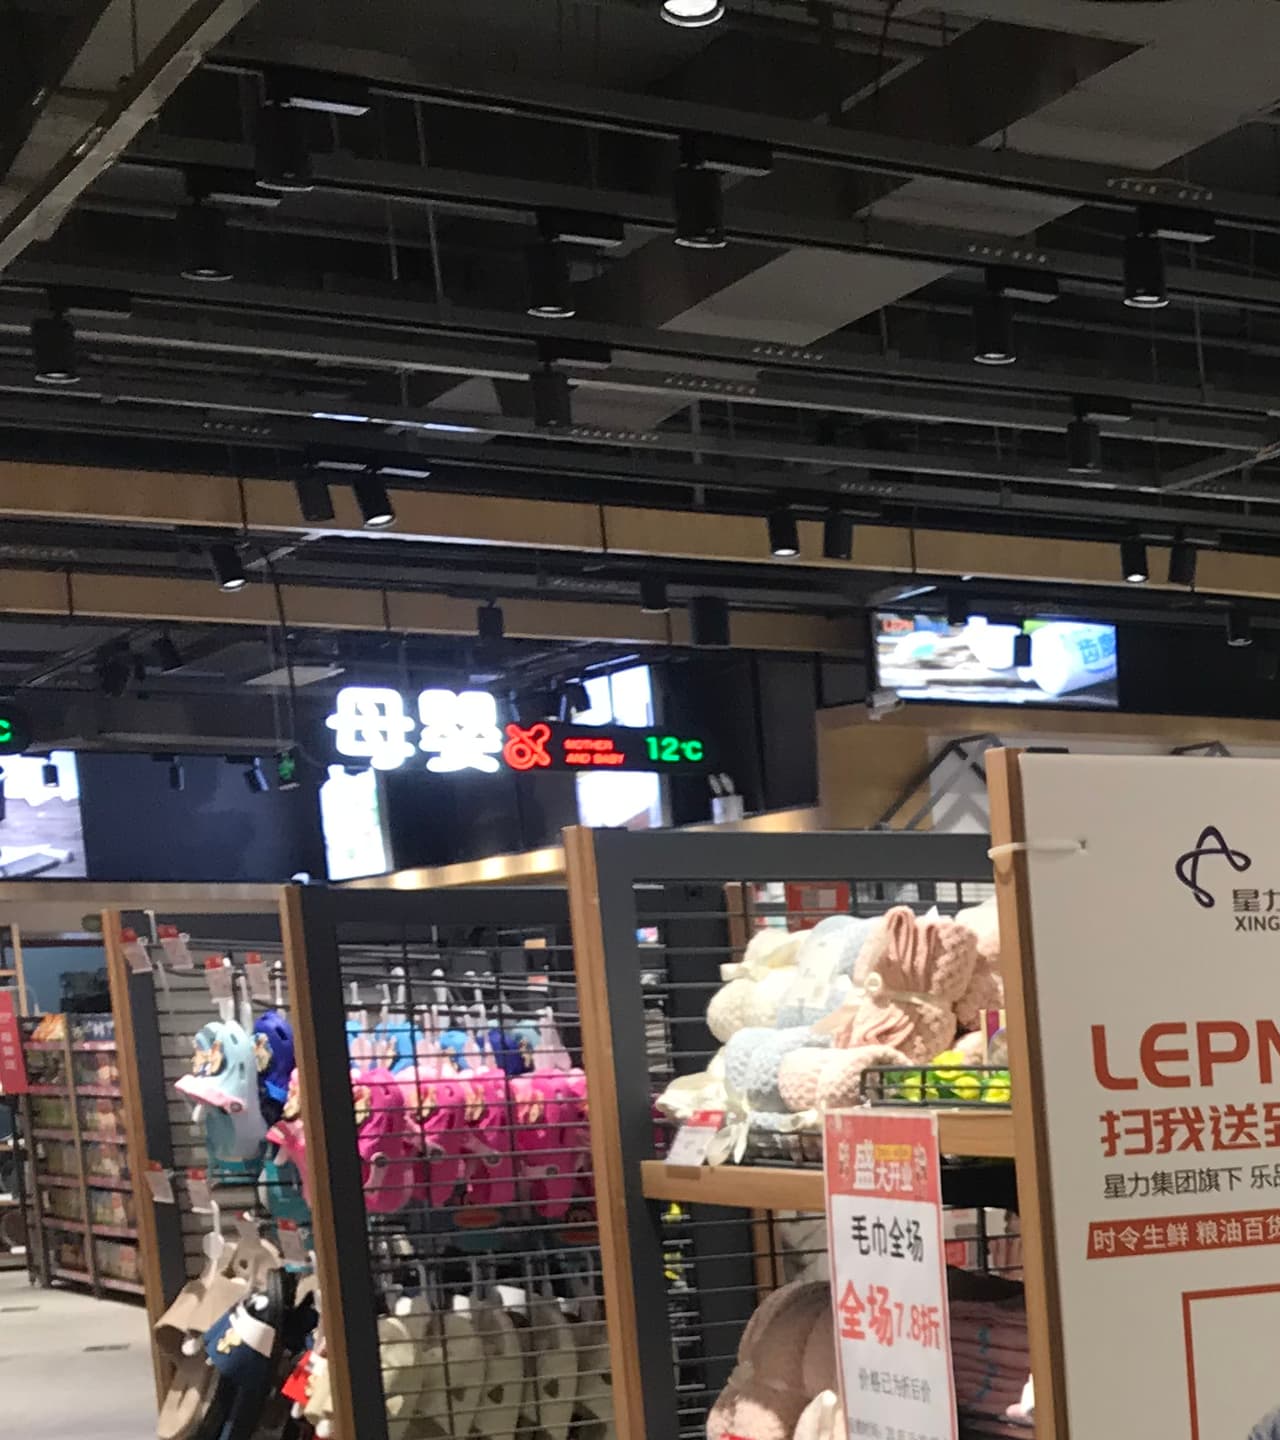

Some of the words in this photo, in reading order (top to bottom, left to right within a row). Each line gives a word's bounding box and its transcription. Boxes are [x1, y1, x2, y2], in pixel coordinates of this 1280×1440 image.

[1103, 1165, 1243, 1200] 星力集团旗下
[851, 1215, 924, 1263] 毛巾全场
[1092, 1219, 1188, 1253] 时令生鲜
[838, 1280, 941, 1350] 全场7.8折
